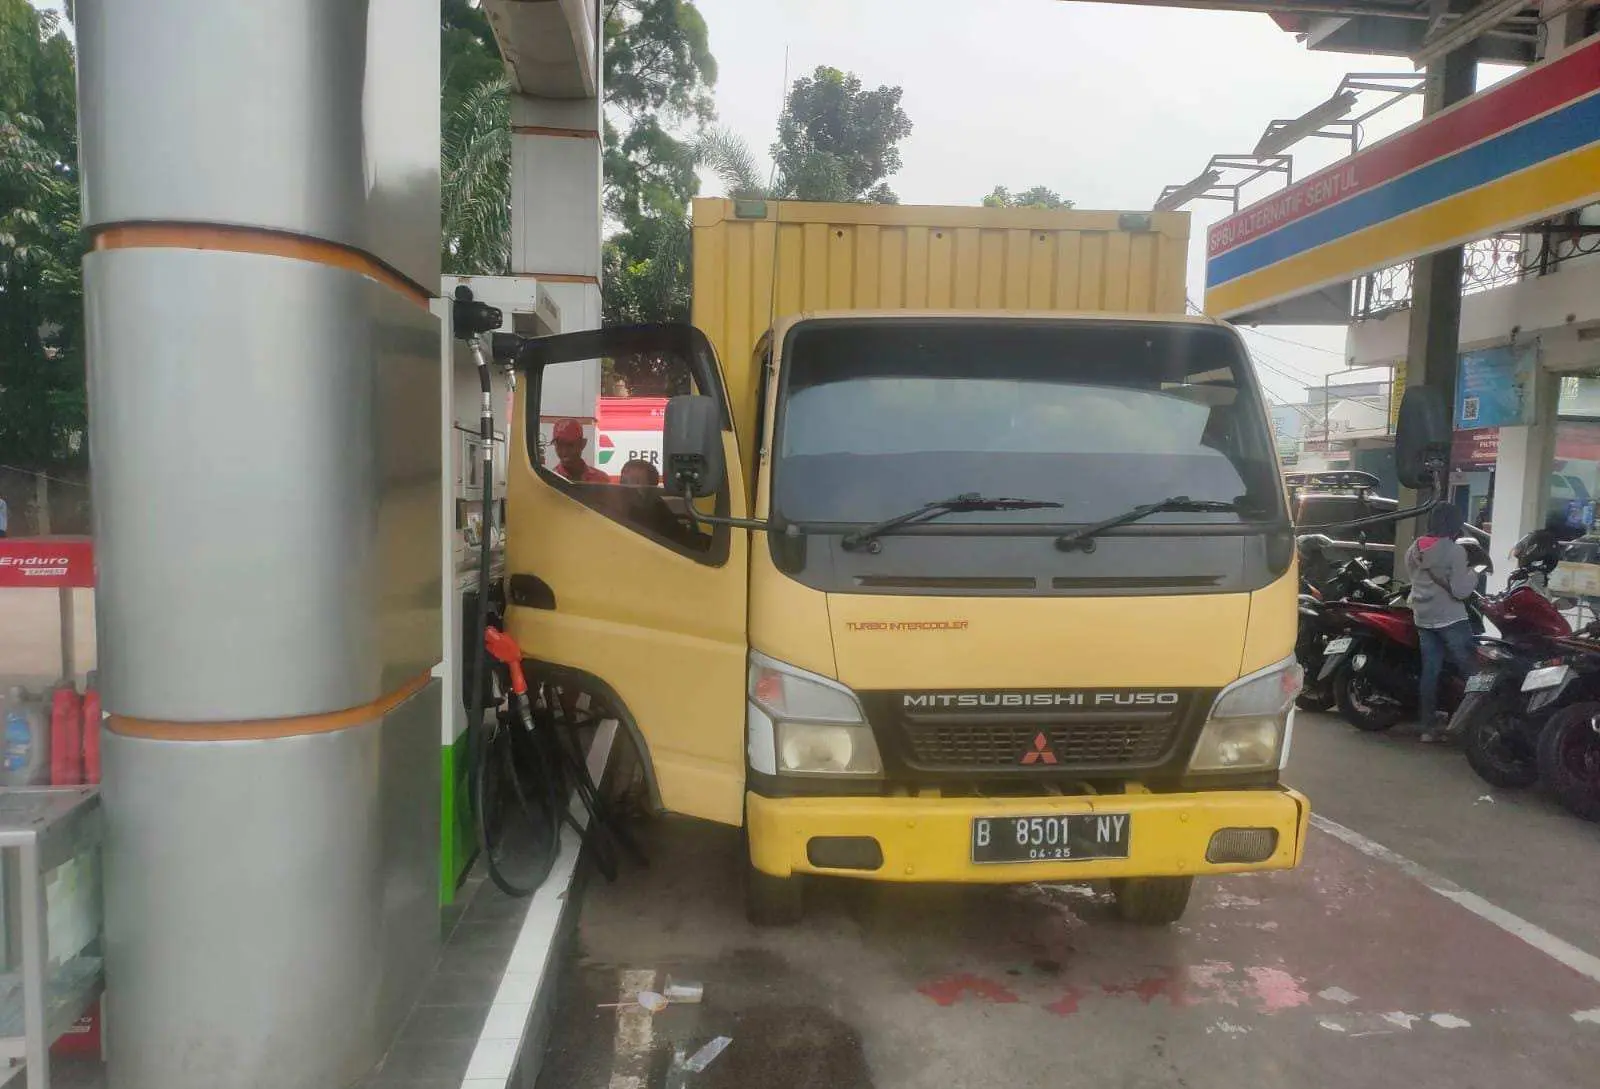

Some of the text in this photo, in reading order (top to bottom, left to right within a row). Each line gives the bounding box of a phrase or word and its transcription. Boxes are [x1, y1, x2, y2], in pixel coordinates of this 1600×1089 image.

[1210, 168, 1360, 250] SPBU ALTERNATIF SENTUL
[0, 556, 69, 565] Enduro
[846, 620, 968, 630] TURBO INTERCOOLER
[903, 693, 1179, 706] MITSUBISHI FUSO
[976, 816, 1125, 846] B 8501 NY
